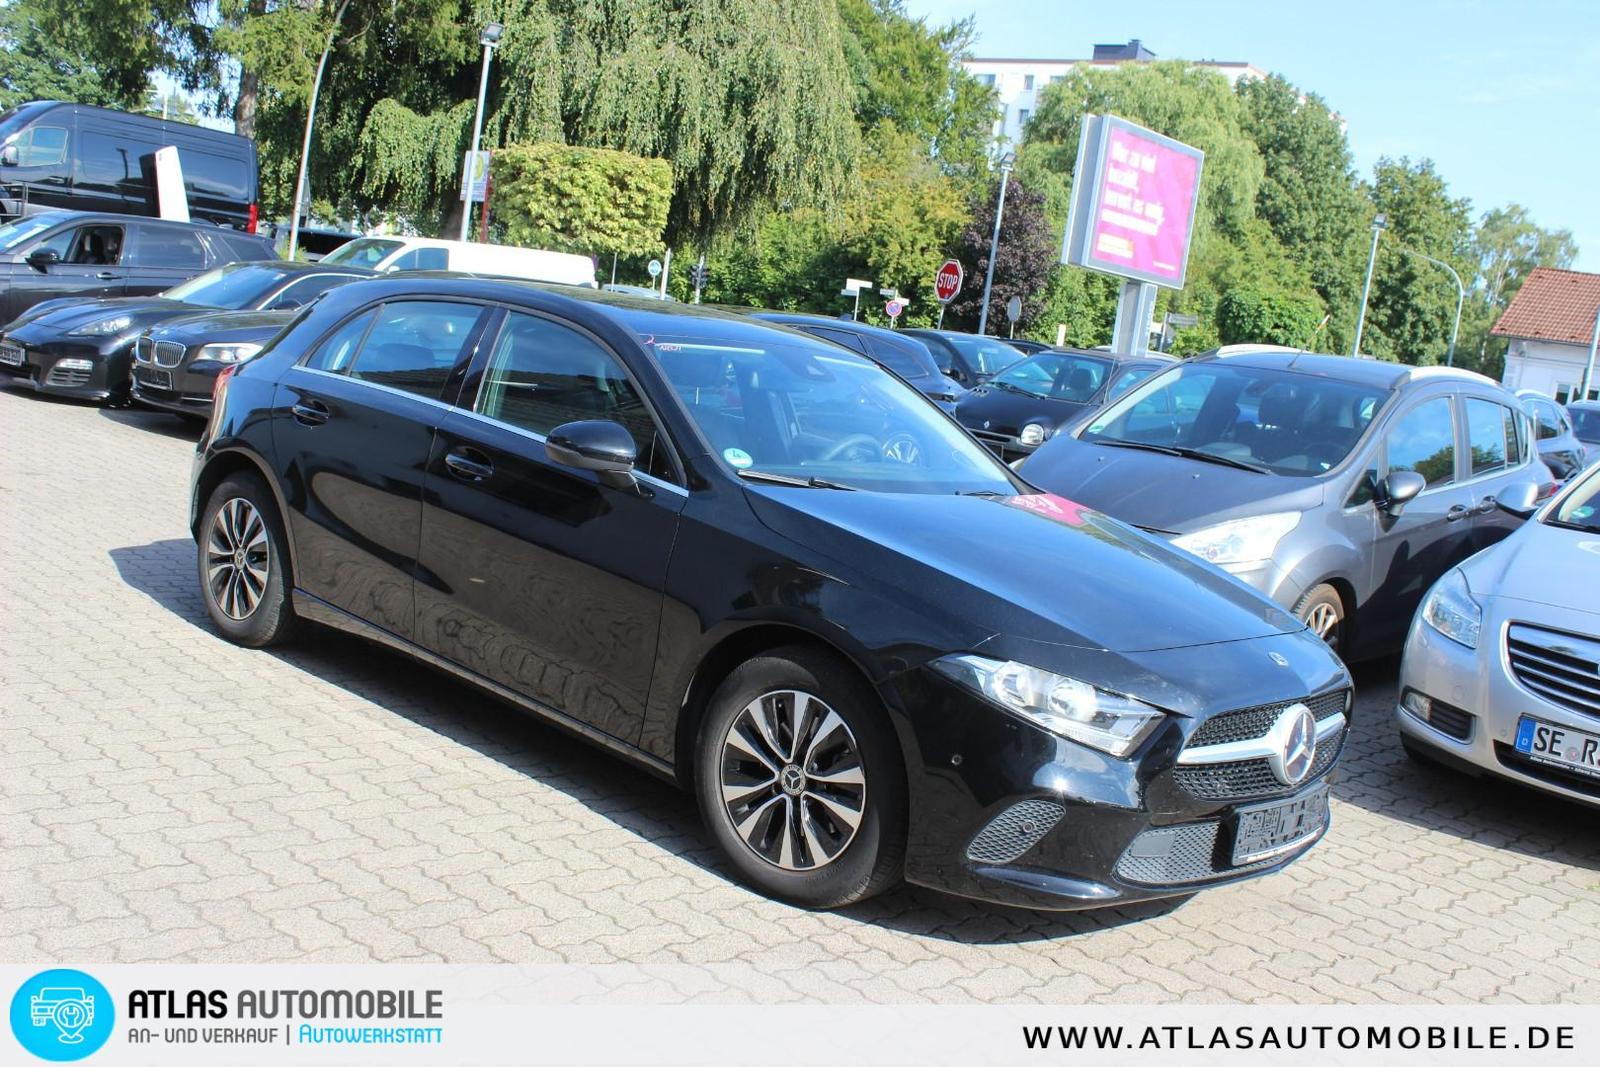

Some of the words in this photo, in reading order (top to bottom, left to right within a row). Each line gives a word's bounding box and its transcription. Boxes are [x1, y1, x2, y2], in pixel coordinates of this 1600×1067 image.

[938, 272, 958, 290] STOP
[1534, 727, 1565, 756] SE
[1581, 738, 1600, 766] R
